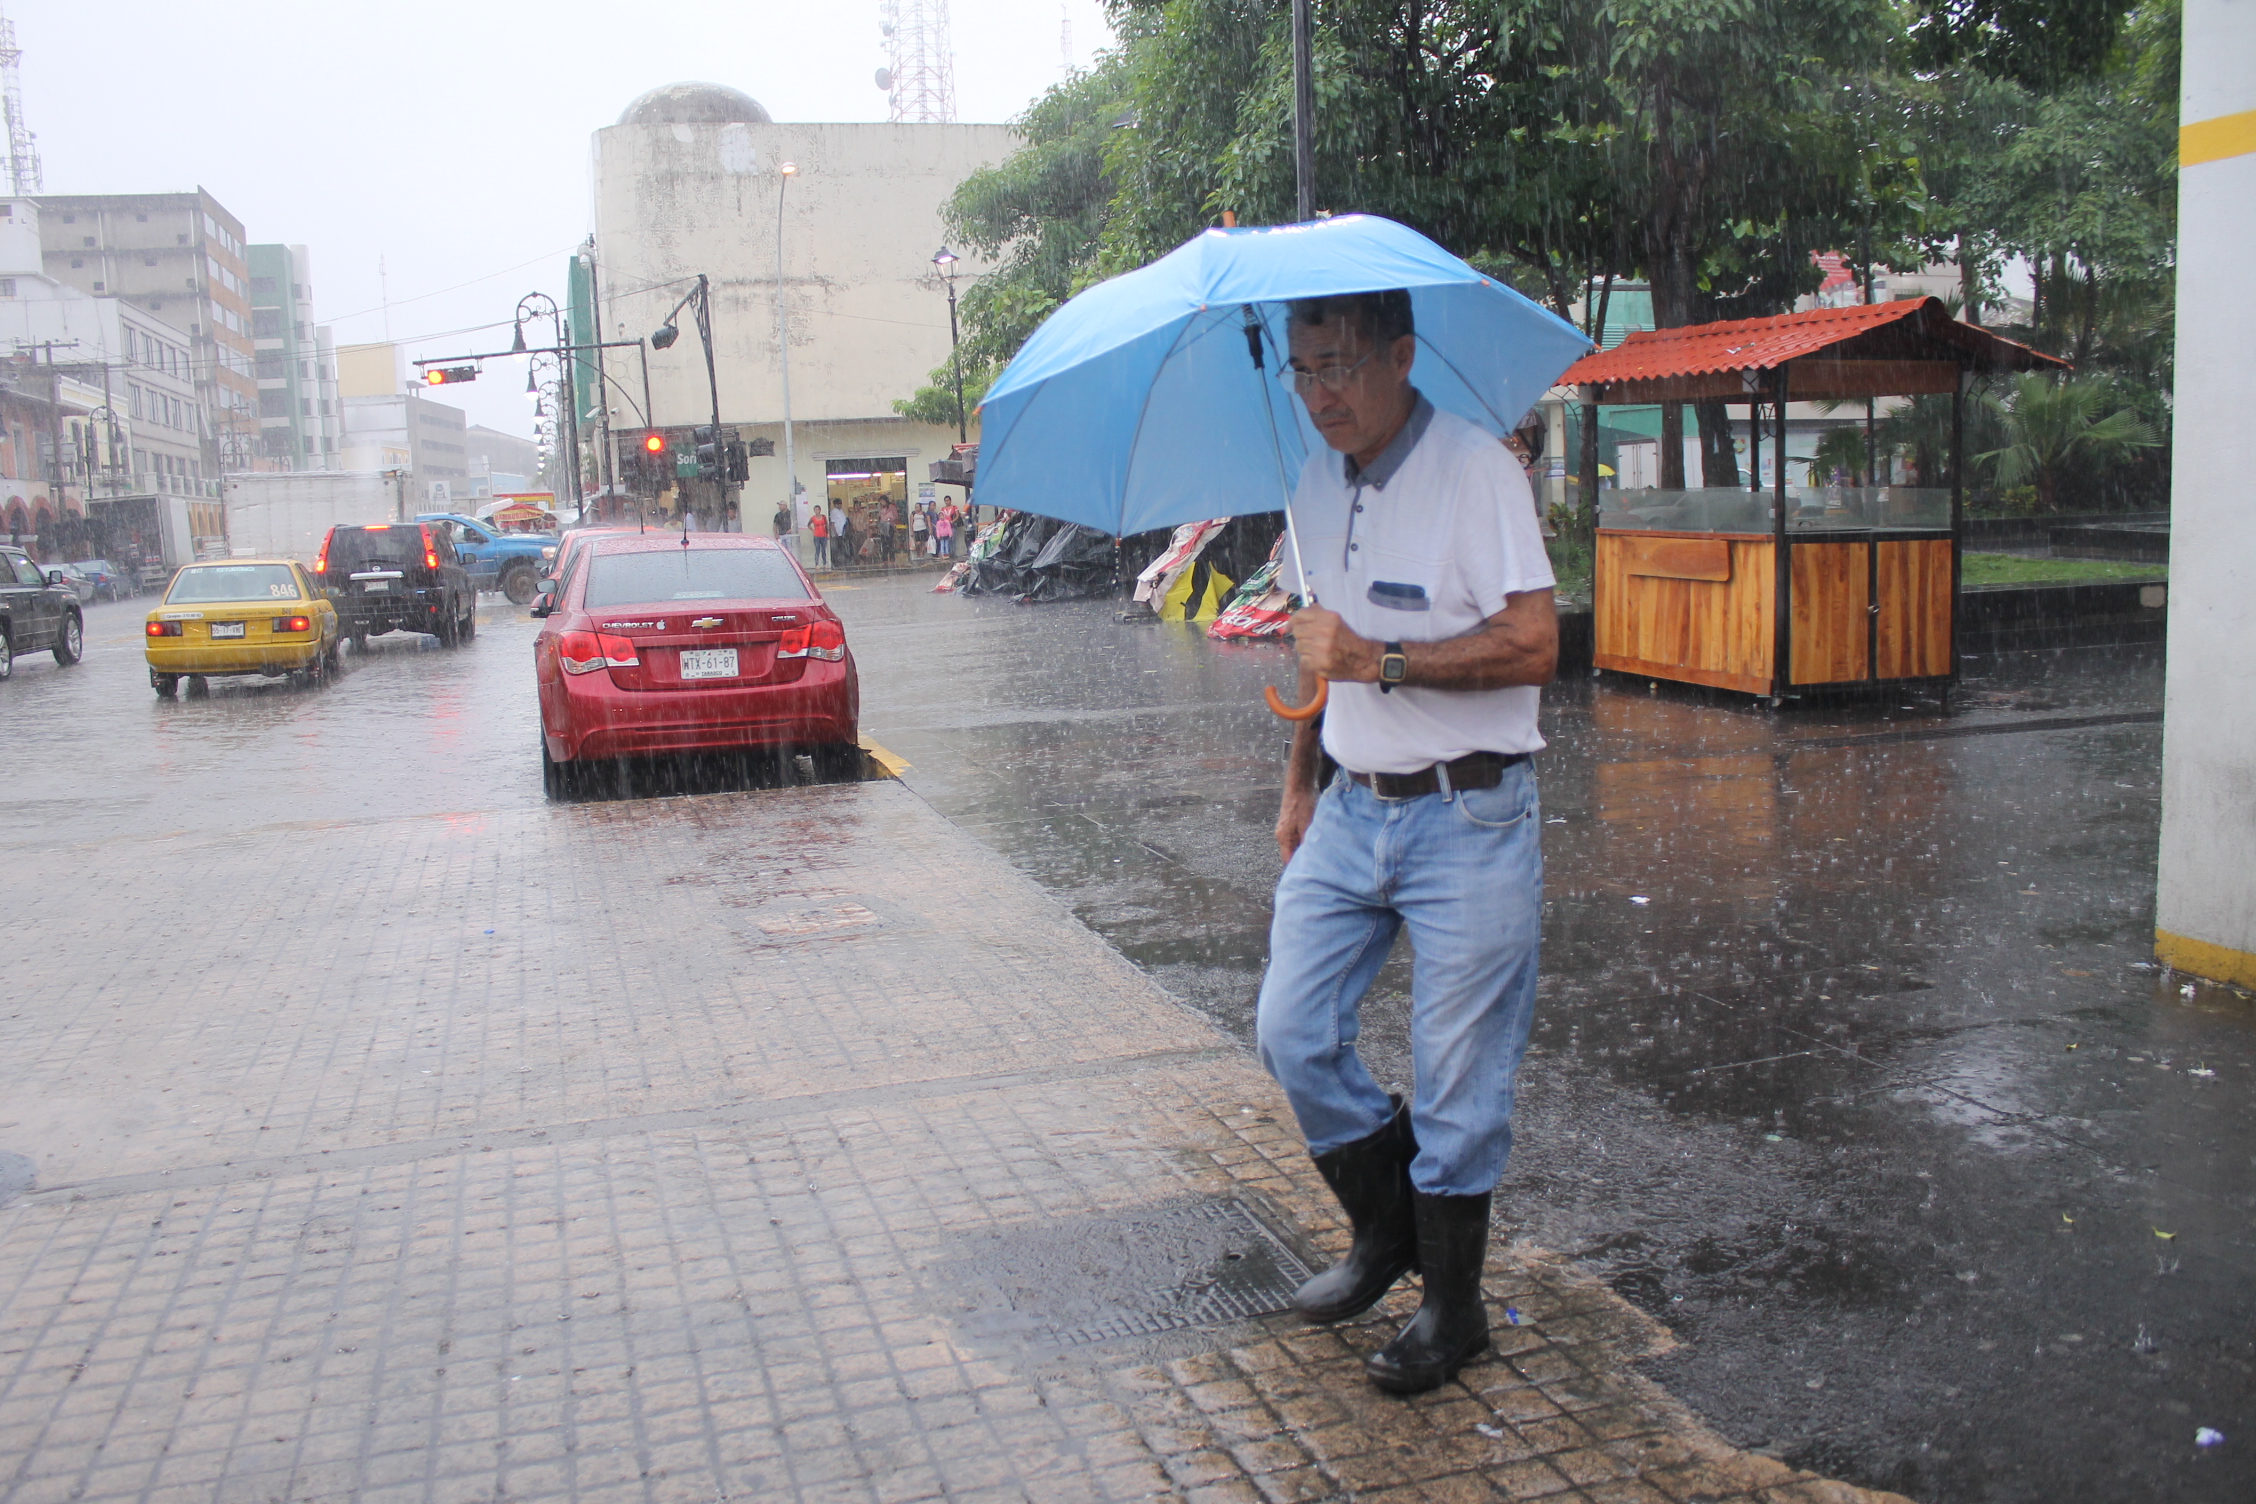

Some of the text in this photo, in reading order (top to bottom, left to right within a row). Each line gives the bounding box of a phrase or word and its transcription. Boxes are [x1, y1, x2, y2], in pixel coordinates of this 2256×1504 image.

[676, 453, 697, 465] Sori
[270, 584, 297, 597] 846
[281, 607, 292, 616] 846
